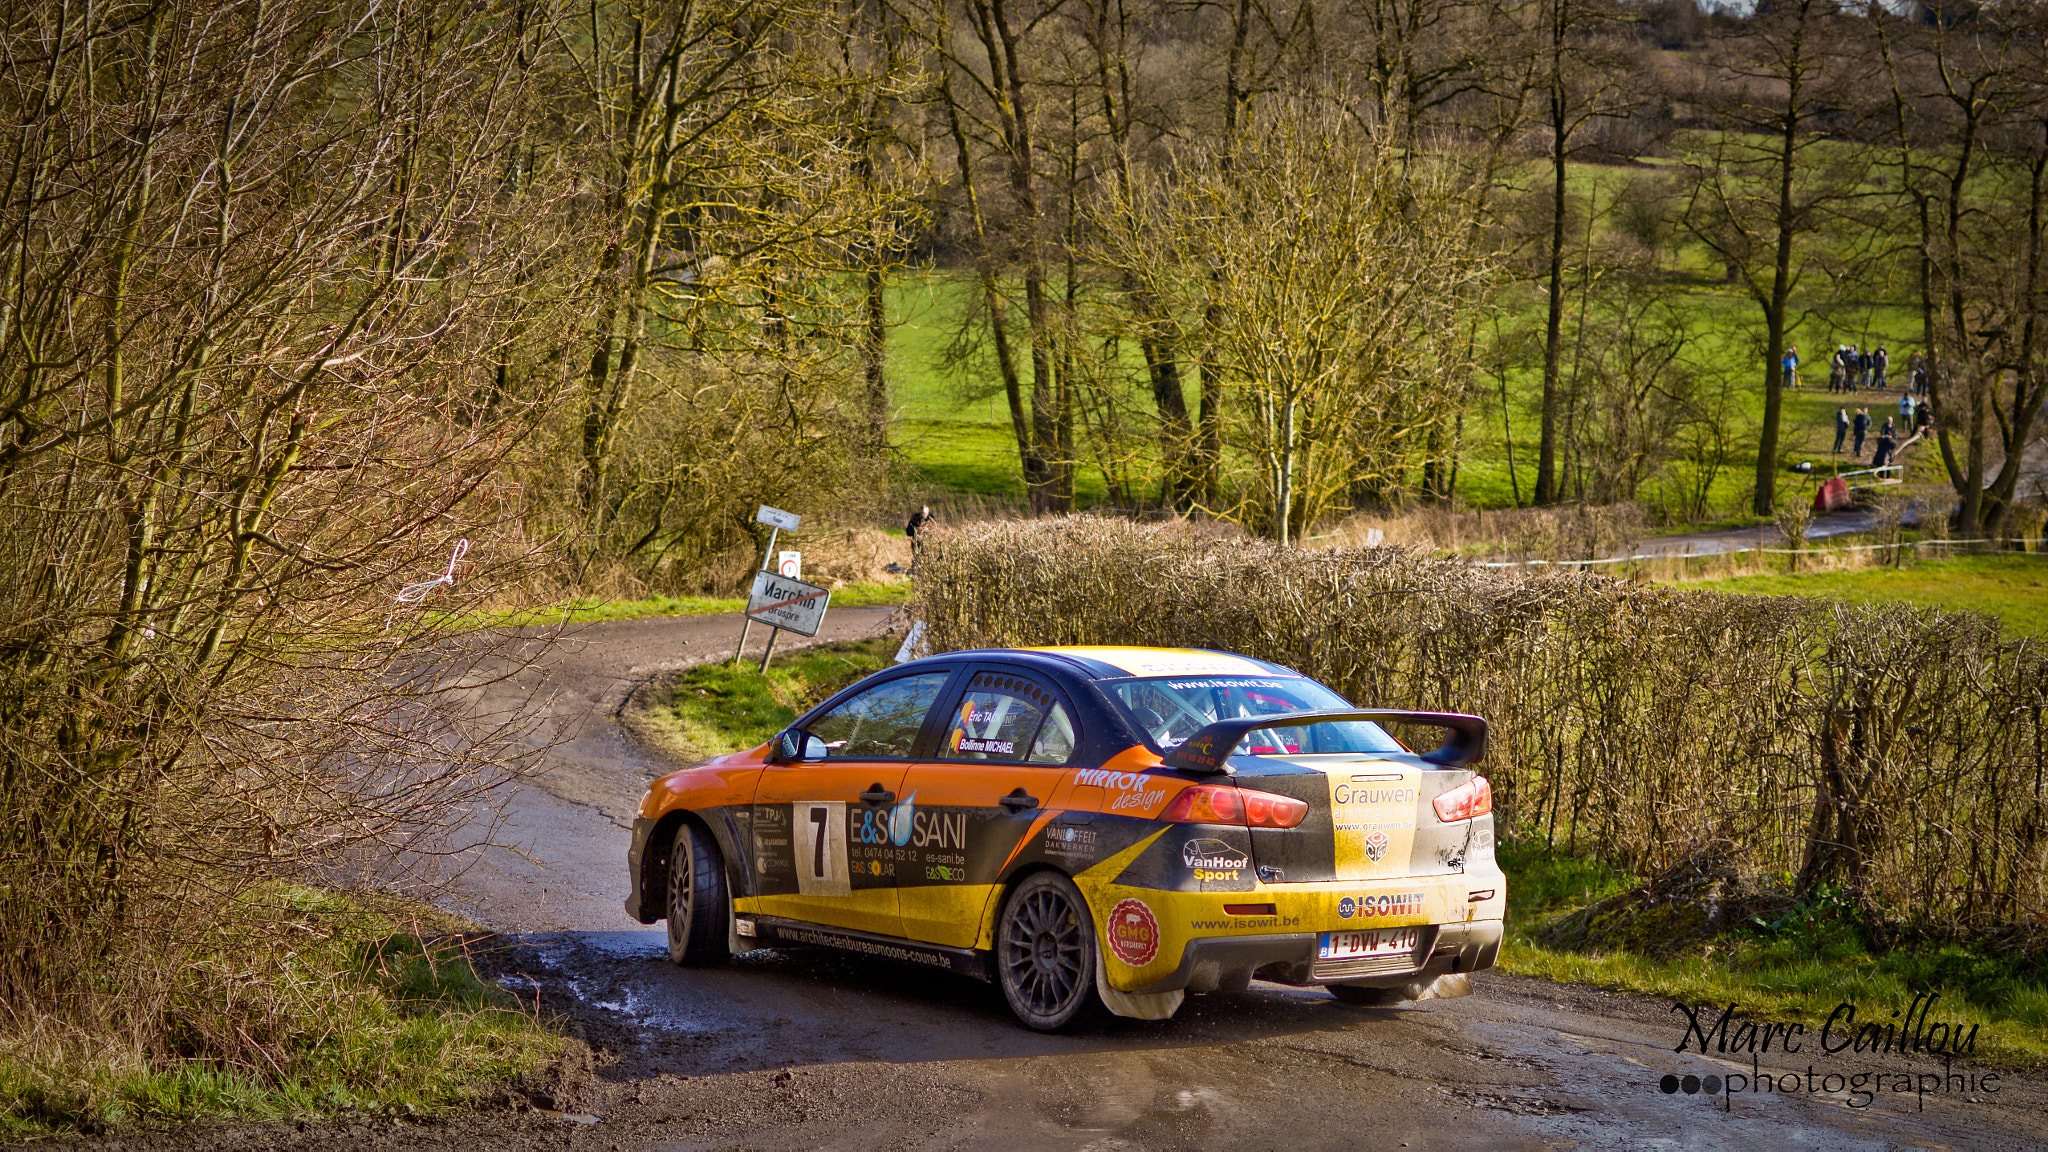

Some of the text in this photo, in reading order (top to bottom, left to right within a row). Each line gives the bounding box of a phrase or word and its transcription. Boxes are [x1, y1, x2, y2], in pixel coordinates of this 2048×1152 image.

[765, 579, 817, 610] Marchin
[768, 608, 800, 622] Bruspre
[1167, 679, 1284, 691] www.isowit.be
[969, 711, 983, 722] Eric
[985, 740, 1014, 754] MICHAEL
[1073, 768, 1150, 793] MIRROR
[1112, 789, 1165, 811] design
[1335, 783, 1415, 805] Grauwen
[1335, 805, 1415, 821] autoparts
[851, 808, 967, 850] E&S SANI
[1335, 820, 1414, 832] www.grauwen.be
[810, 807, 828, 878] 7
[1045, 840, 1096, 853] DAKWERKEN
[852, 848, 917, 861] tel. 0474 04 52 12
[926, 853, 965, 865] es-sani.be
[1183, 855, 1248, 868] VanHoof
[1193, 868, 1239, 882] Sport
[1357, 892, 1425, 918] ISOWIT
[1191, 915, 1300, 929] www.isowit.be
[1117, 924, 1151, 940] GMG
[1321, 946, 1328, 957] B
